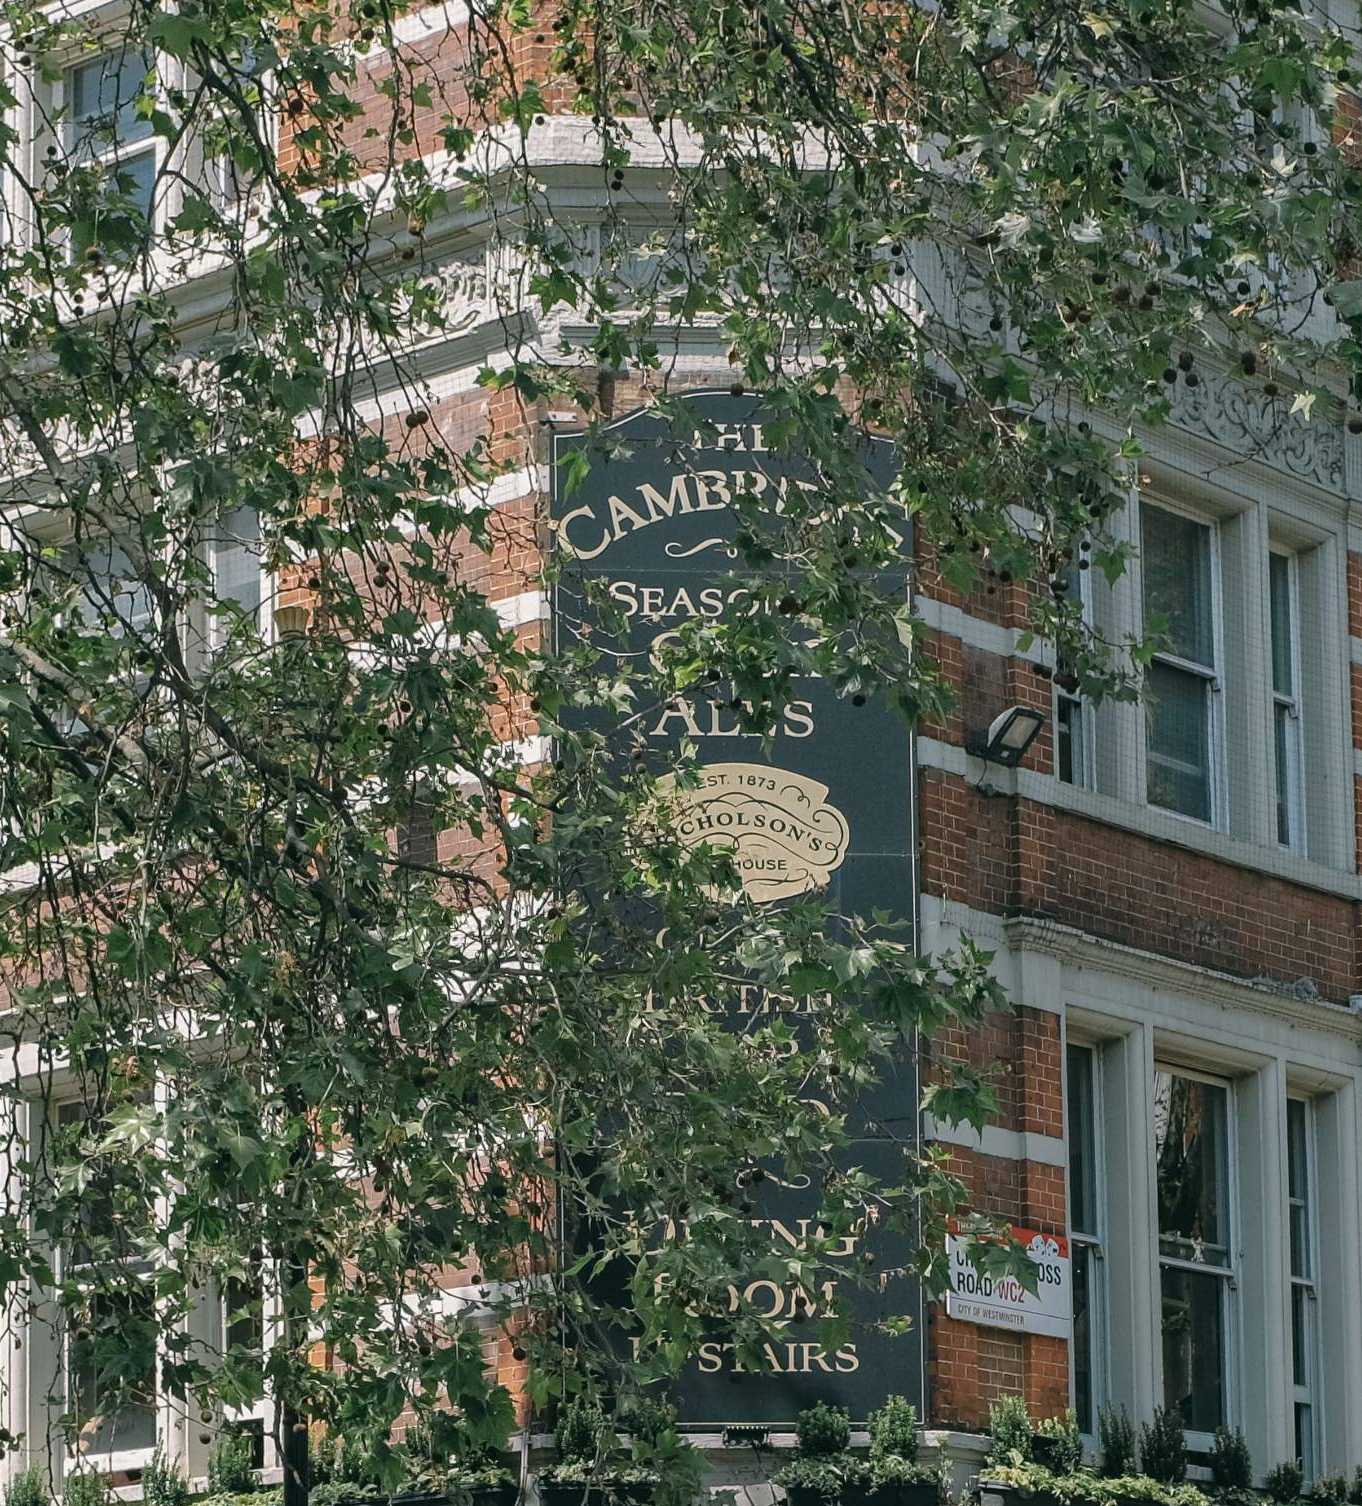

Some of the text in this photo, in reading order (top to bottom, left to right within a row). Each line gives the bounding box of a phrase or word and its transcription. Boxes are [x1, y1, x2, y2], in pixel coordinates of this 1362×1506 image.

[738, 775, 776, 791] 1873
[669, 812, 823, 852] CHOLSON'S
[956, 1271, 1025, 1304] ROAD WC2
[957, 1303, 1025, 1326] CITY OF WESTMINSTER
